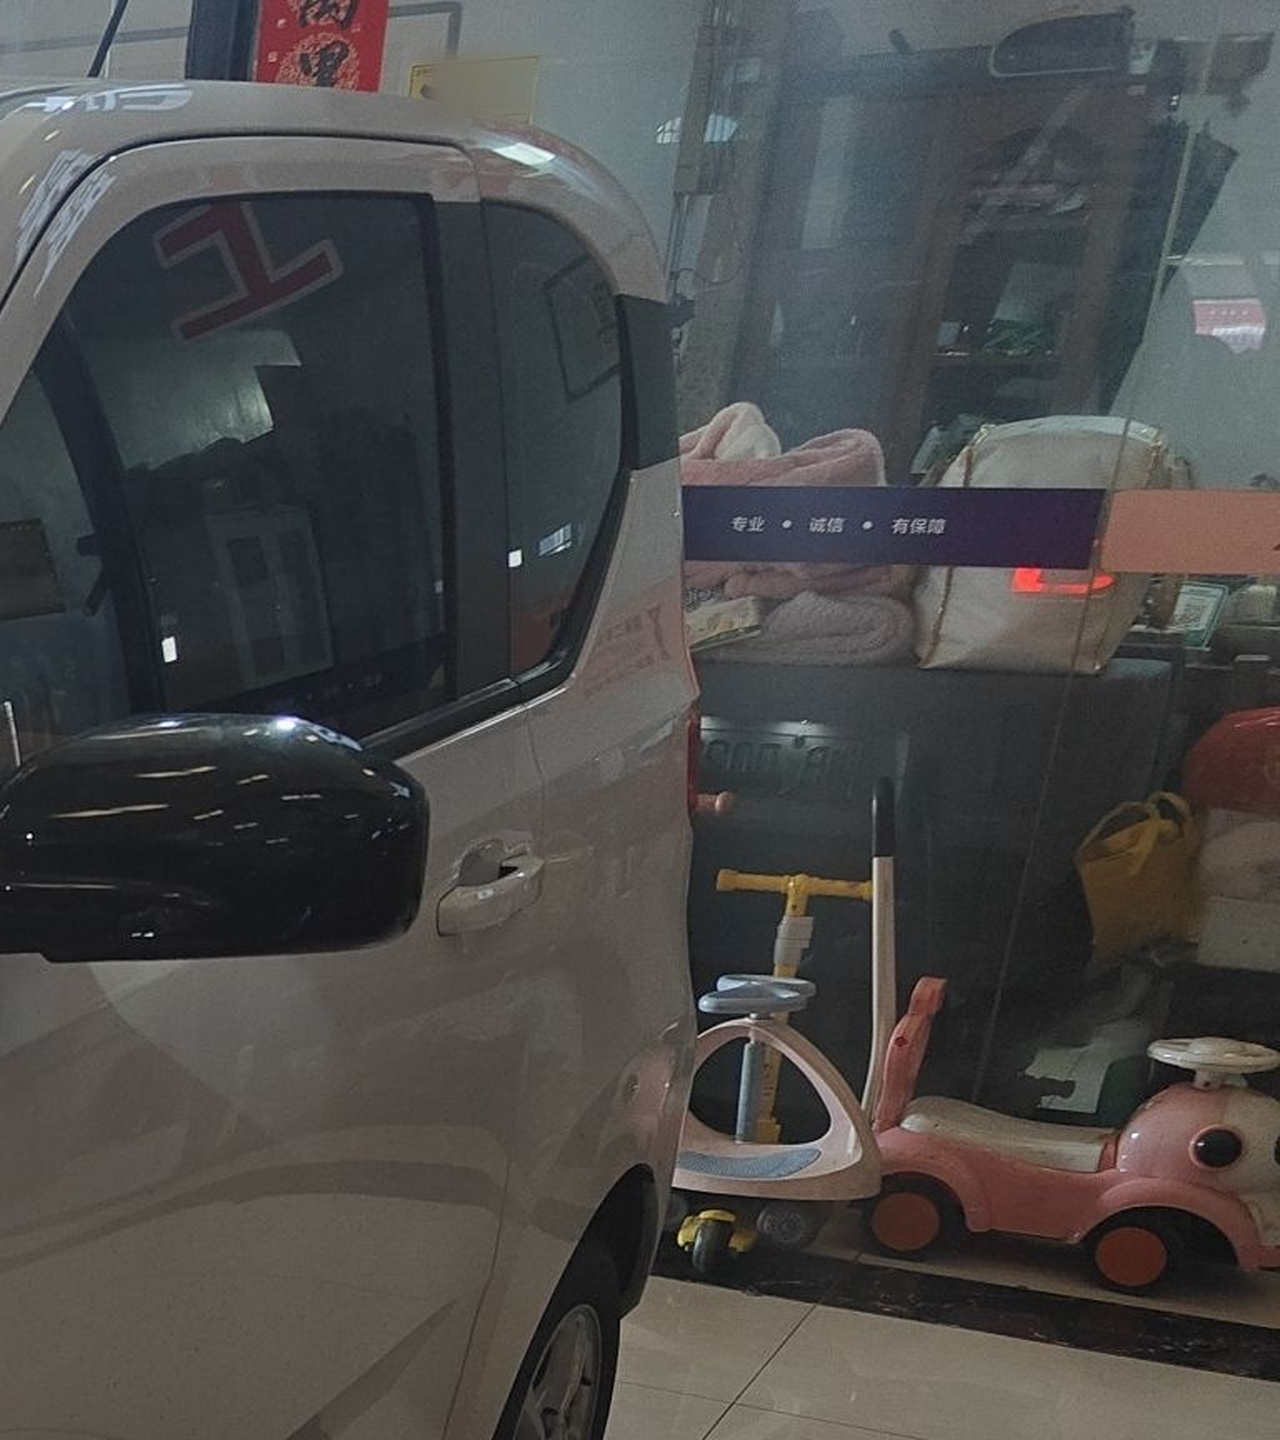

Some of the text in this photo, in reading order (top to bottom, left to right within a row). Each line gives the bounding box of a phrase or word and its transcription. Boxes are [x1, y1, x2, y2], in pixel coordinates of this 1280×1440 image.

[731, 516, 948, 535] 专业 诚信 有保障
